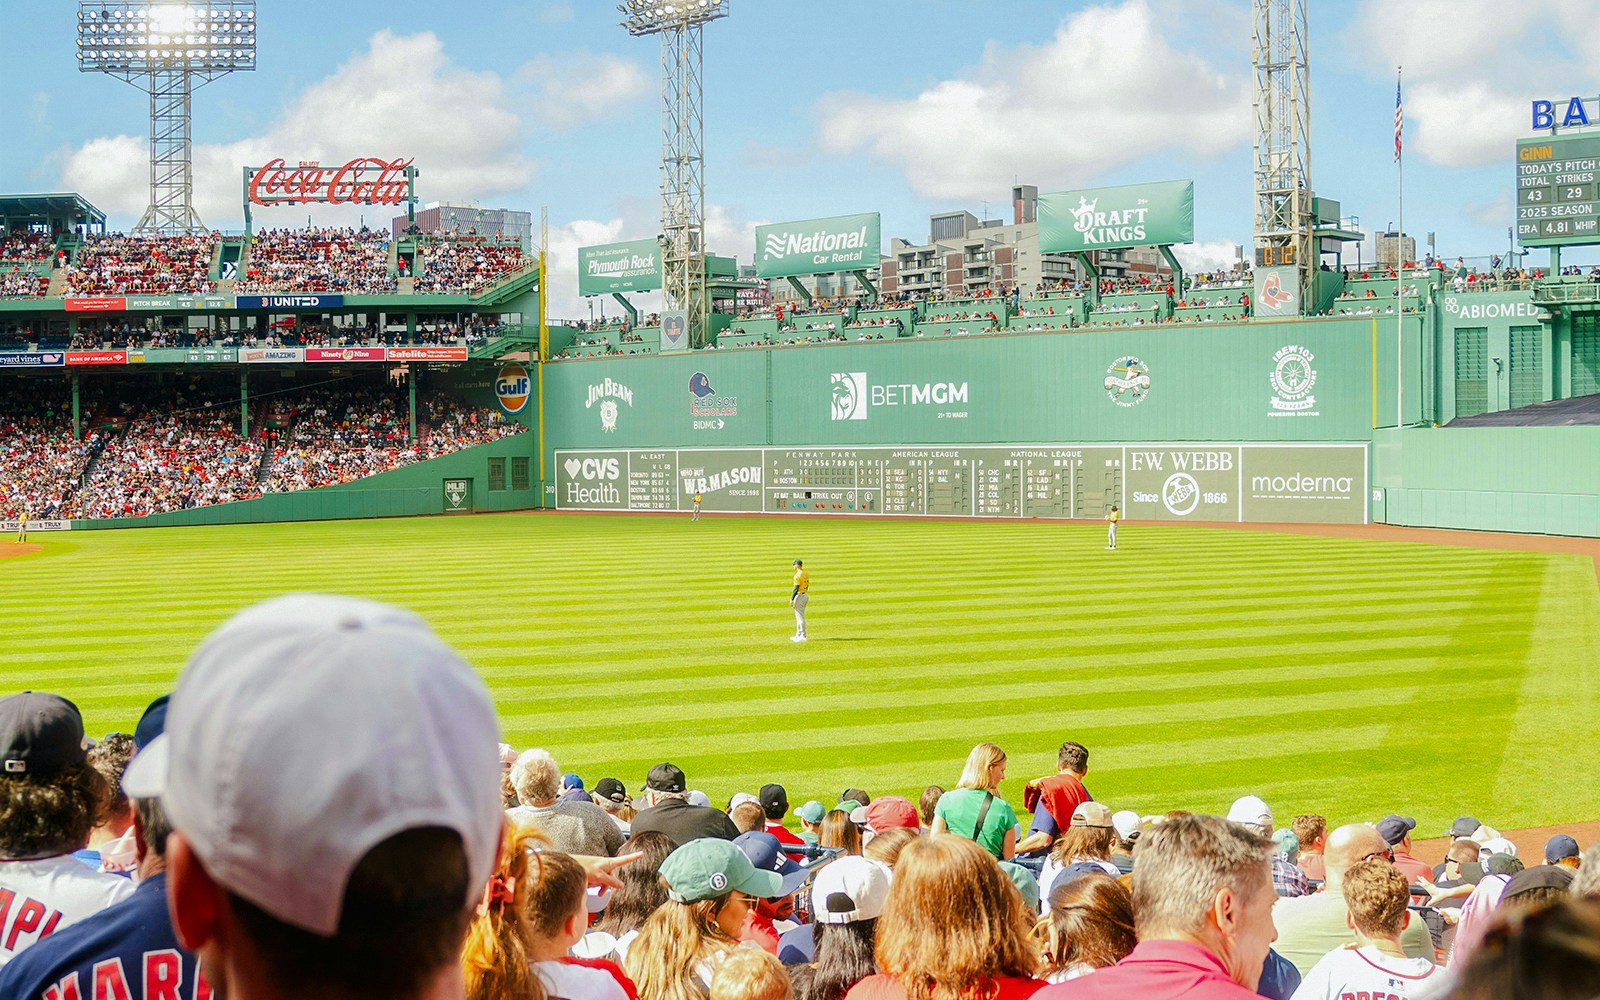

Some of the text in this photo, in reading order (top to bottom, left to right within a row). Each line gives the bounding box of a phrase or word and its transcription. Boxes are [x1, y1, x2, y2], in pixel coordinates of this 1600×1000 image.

[1532, 94, 1600, 130] BA
[1520, 146, 1553, 160] GINN
[1520, 163, 1562, 174] TODAY'S
[1565, 160, 1595, 171] PITCH
[248, 157, 415, 205] Coca-Cola
[1520, 173, 1594, 186] TOTAL STRIKES
[1527, 188, 1582, 201] 43 29
[1520, 204, 1592, 218] 2025 SEASON
[1073, 208, 1148, 232] DRAFT
[1518, 220, 1597, 234] ERA 4.81 WHIP
[1083, 225, 1146, 245] KINGS
[588, 253, 654, 274] Plymouth Rock
[813, 251, 862, 264] Car Rental
[274, 297, 319, 307] UNITED
[1460, 303, 1538, 318] ABIOMED
[21, 354, 41, 362] vines
[389, 350, 427, 358] Safelite
[1272, 345, 1314, 362] IBEW 103
[497, 379, 528, 395] Gulf
[585, 378, 634, 408] JIM BEAM
[872, 382, 968, 406] BETMGM
[695, 397, 737, 407] RED SOX
[694, 408, 737, 417] SCHOLARS
[694, 421, 717, 430] BIDMC
[1130, 451, 1233, 471] F.W. WEBB
[582, 458, 620, 480] CVS
[1252, 472, 1353, 492] moderna
[545, 486, 555, 494] 310
[566, 482, 620, 503] Health
[1133, 491, 1228, 504] Since 1866
[714, 875, 724, 888] B
